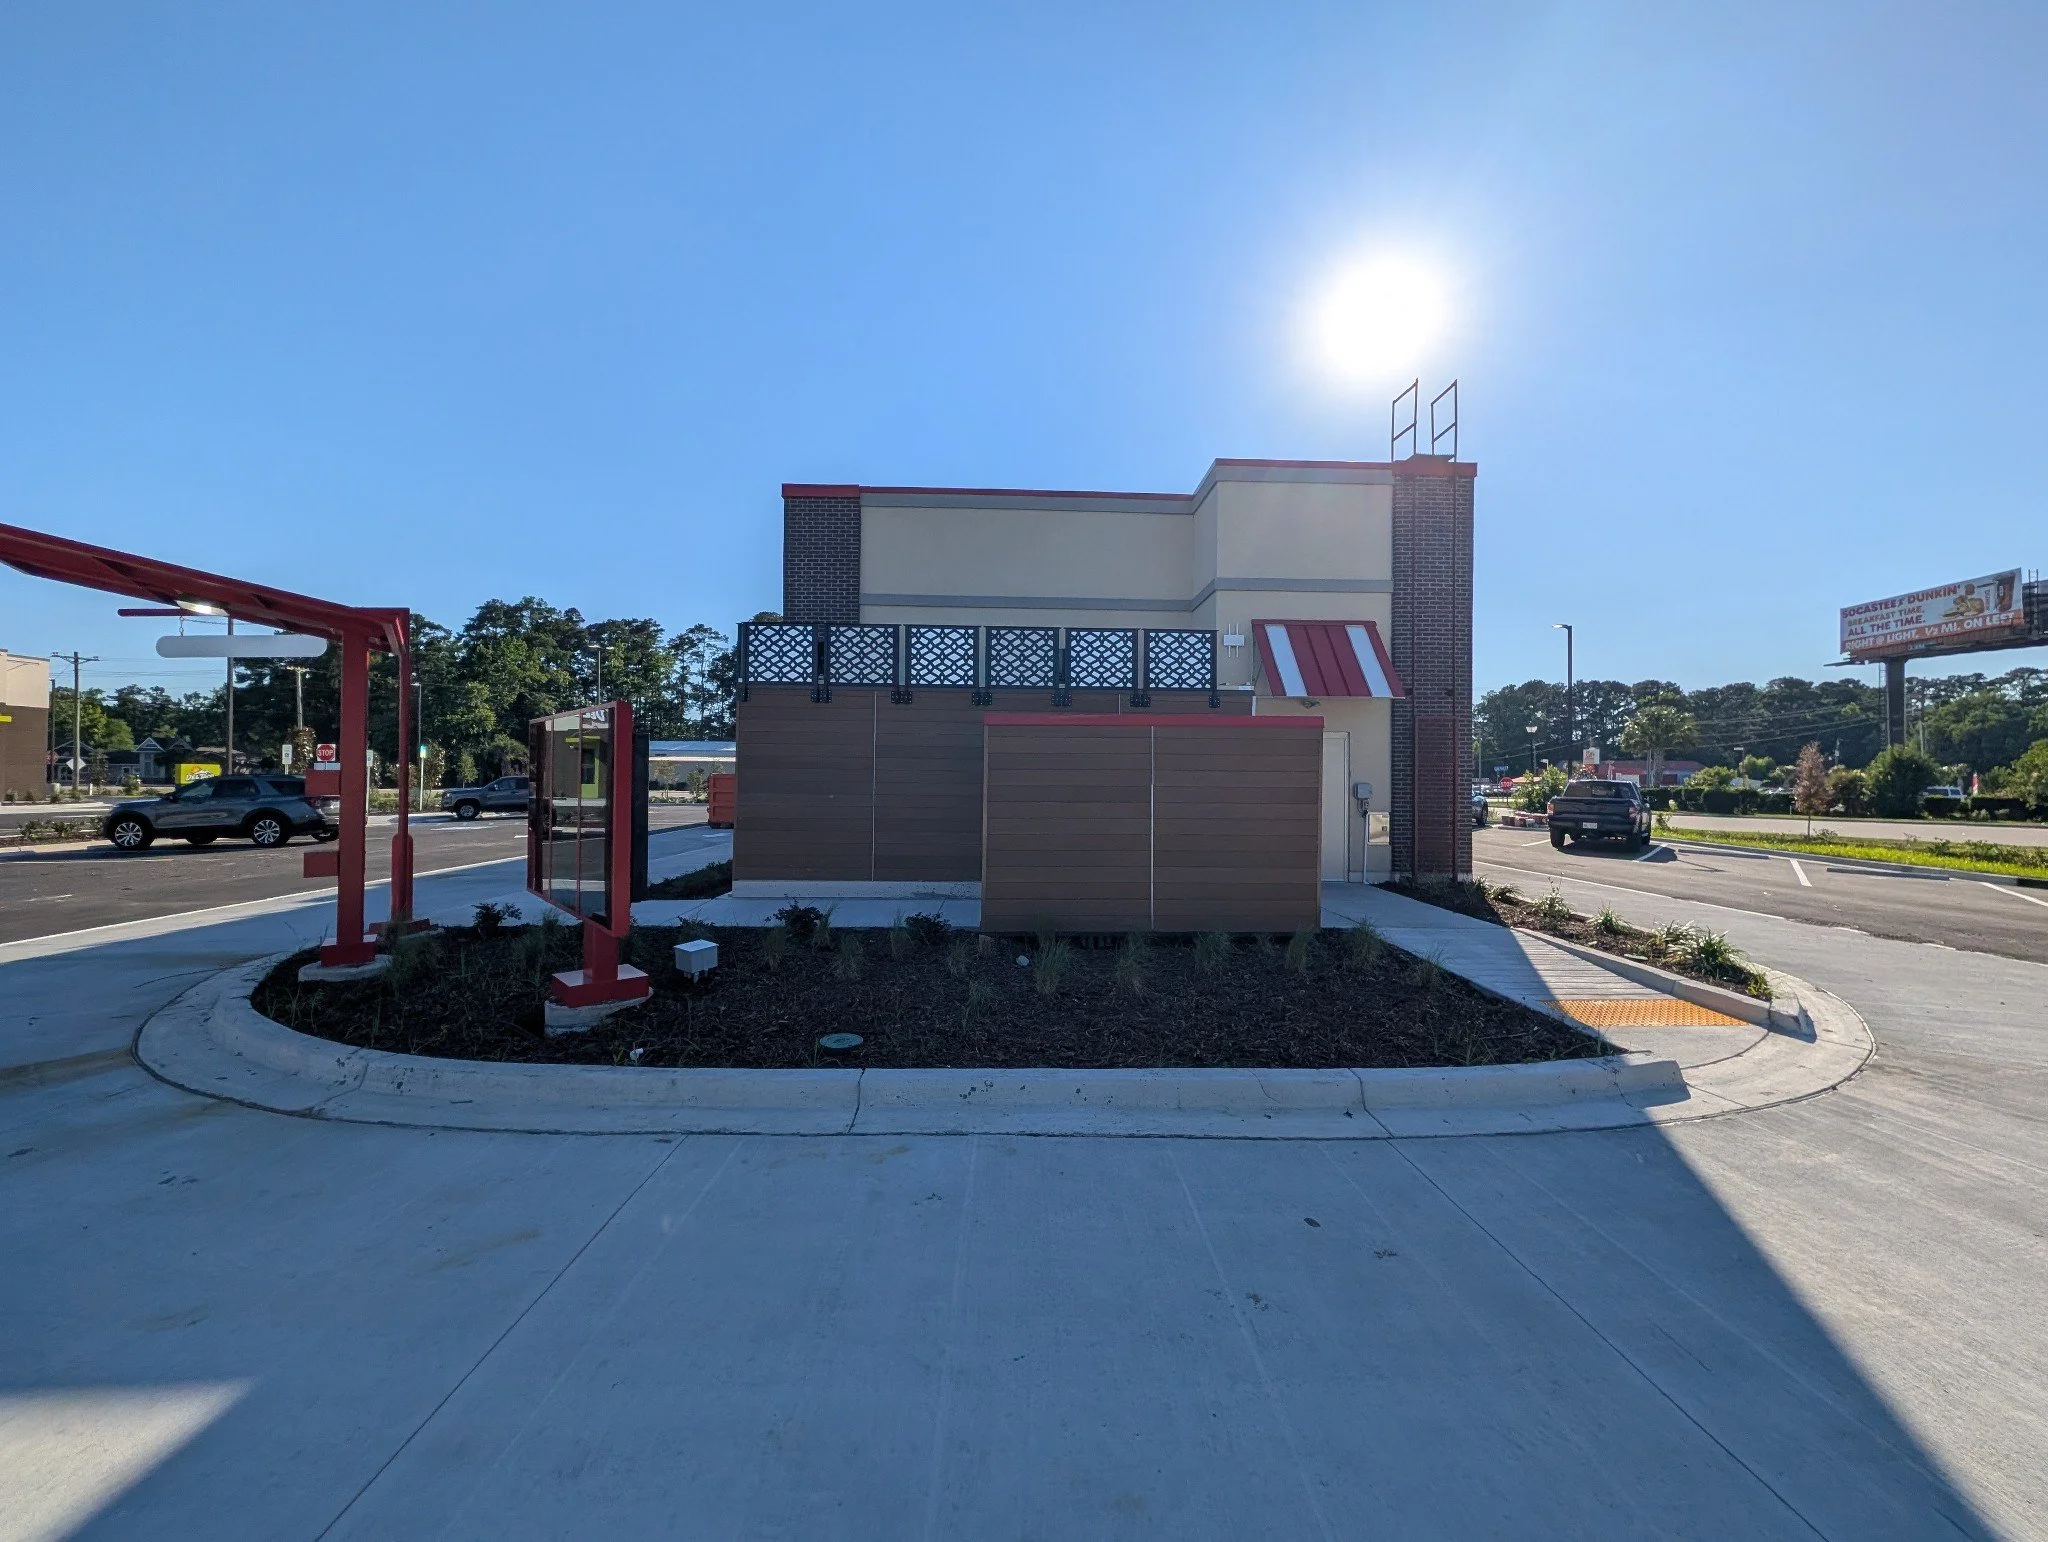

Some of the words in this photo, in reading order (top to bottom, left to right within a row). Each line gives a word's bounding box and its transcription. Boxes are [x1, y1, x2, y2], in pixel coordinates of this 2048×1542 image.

[1907, 583, 1961, 605] DUNKIN'
[1847, 625, 1867, 637] ALL
[1869, 621, 1891, 632] THE
[1893, 615, 1926, 629] TIME.
[1848, 610, 1896, 627] BREAKFAST
[1845, 636, 1877, 651] RIGHT
[1964, 617, 1983, 629] ON
[1986, 612, 2014, 626] LEFT
[317, 749, 334, 757] STOP
